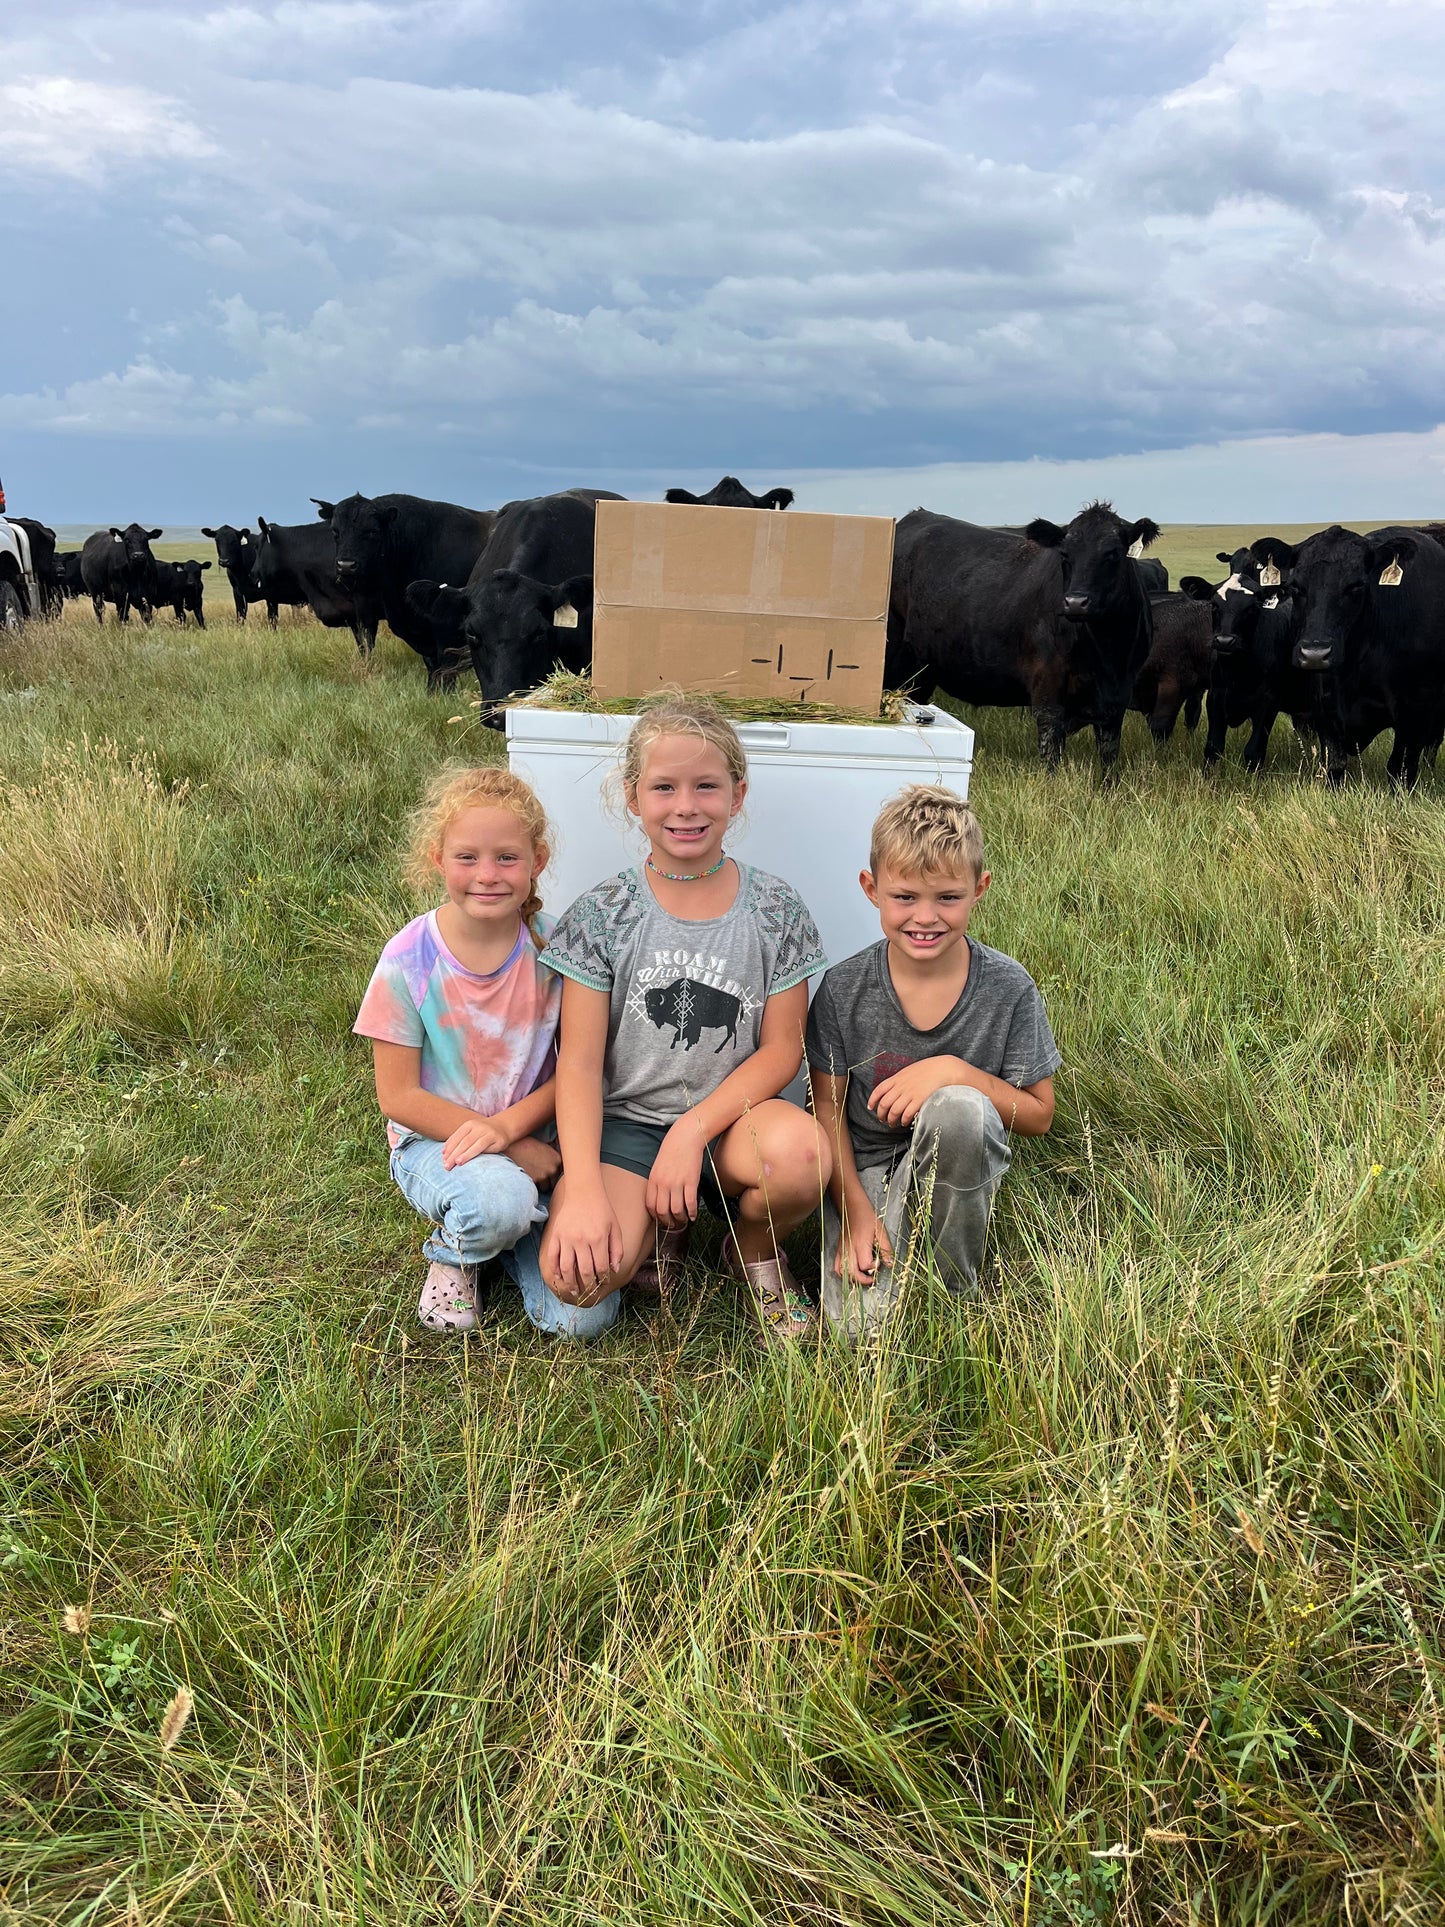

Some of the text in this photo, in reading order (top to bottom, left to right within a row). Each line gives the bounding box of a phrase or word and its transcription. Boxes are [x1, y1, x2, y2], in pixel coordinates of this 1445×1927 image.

[637, 966, 680, 982] With
[654, 950, 727, 974] ROAM
[685, 965, 741, 997] WILD
